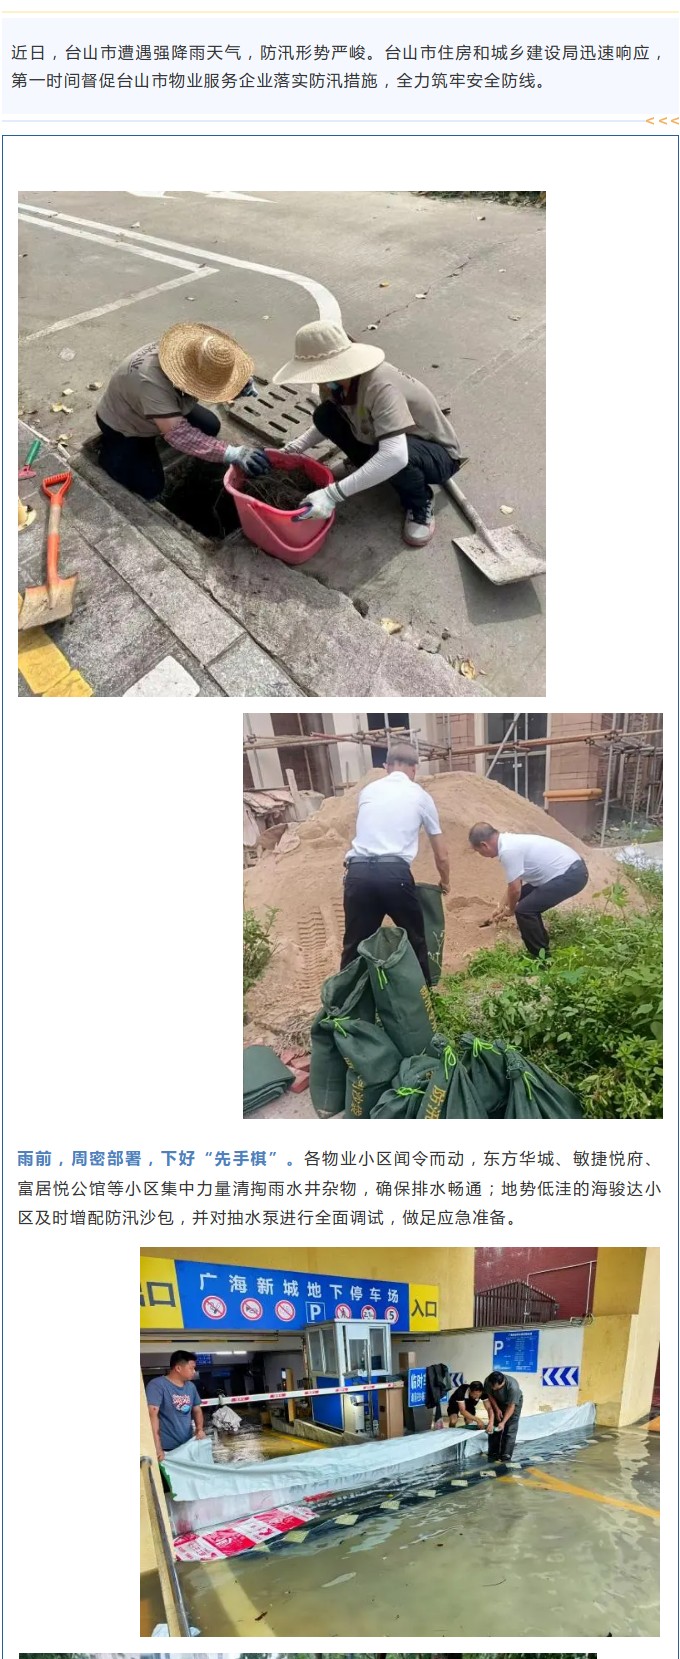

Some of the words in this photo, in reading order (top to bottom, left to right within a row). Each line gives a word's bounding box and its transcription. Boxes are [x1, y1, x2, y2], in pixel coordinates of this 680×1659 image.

[11, 43, 662, 61] 近日，台山市遭遇强降雨天气，防汛形势严峻。台山市住房和城乡建设局迅速响应，
[11, 71, 545, 89] 第一时间督促台山市物业服务企业落实防汛措施，全力筑牢安全防线。
[17, 1179, 662, 1197] 富居悦公馆等小区集中力量清掏雨水井杂物，确保排水畅通；地势低洼的海骏达小
[18, 1208, 517, 1226] 区及时增配防汛沙包，并对抽水泵进行全面调试，做足应急准备。
[199, 1272, 399, 1304] 广海新城地下停车场
[309, 1304, 321, 1321] P
[411, 1299, 437, 1317] 入口
[494, 1340, 505, 1356] P
